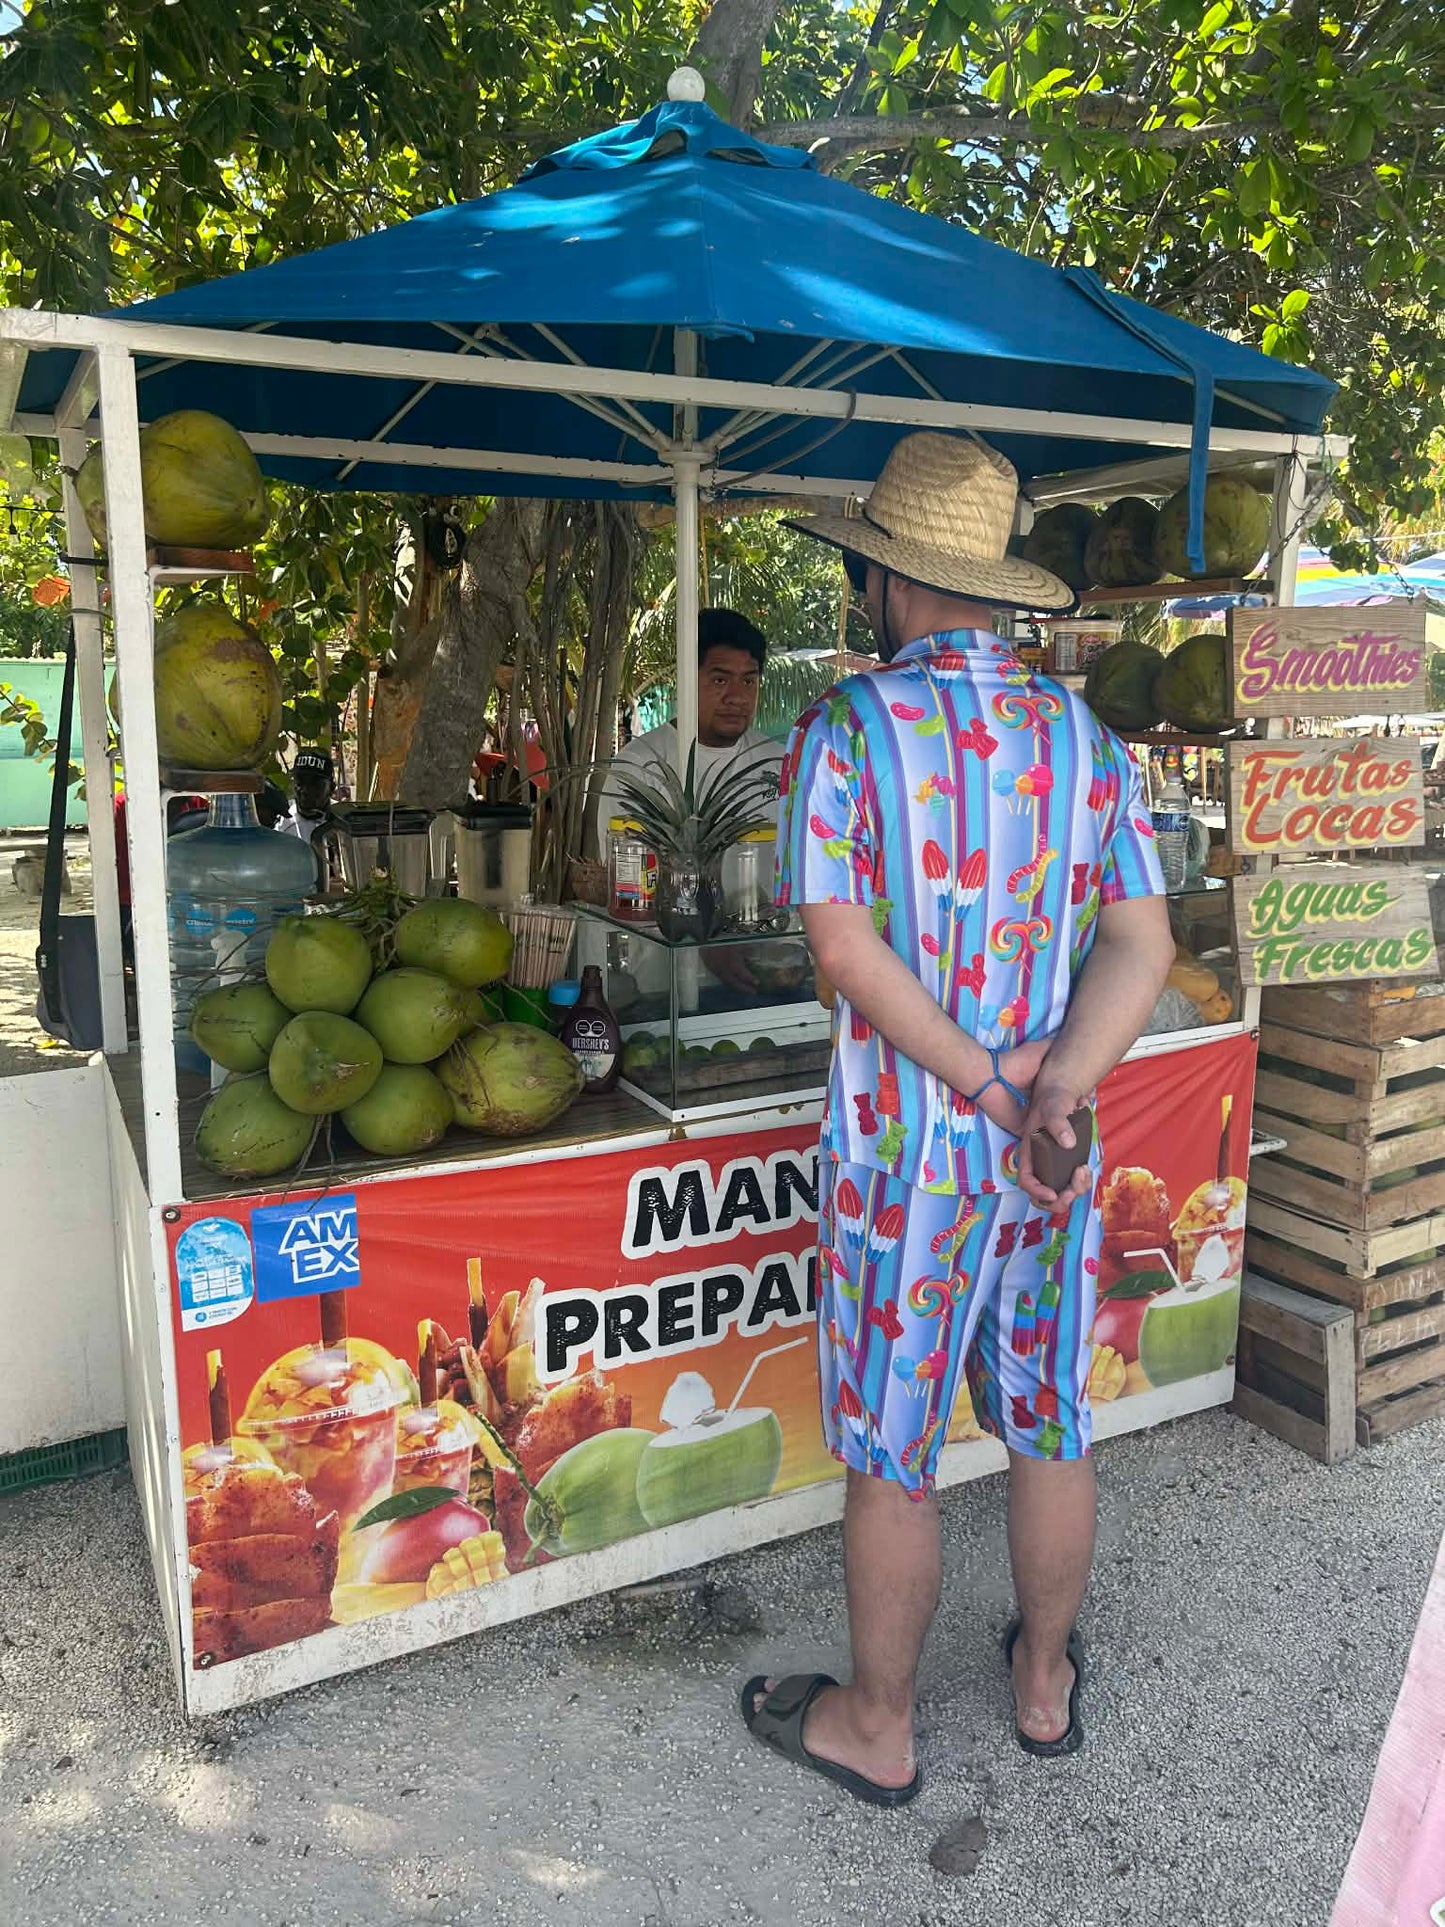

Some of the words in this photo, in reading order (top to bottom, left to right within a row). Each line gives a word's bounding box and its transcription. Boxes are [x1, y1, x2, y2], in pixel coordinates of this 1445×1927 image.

[1238, 620, 1421, 702] Smoothies
[1242, 741, 1421, 810] Frutas
[1243, 793, 1423, 850] Locas
[1247, 878, 1404, 938] Aguas
[1254, 927, 1433, 984] Frescas
[572, 1037, 610, 1050] HERSHEY'S
[279, 1207, 357, 1254] AM
[293, 1240, 360, 1283] EX
[546, 1257, 817, 1372] PREPA
